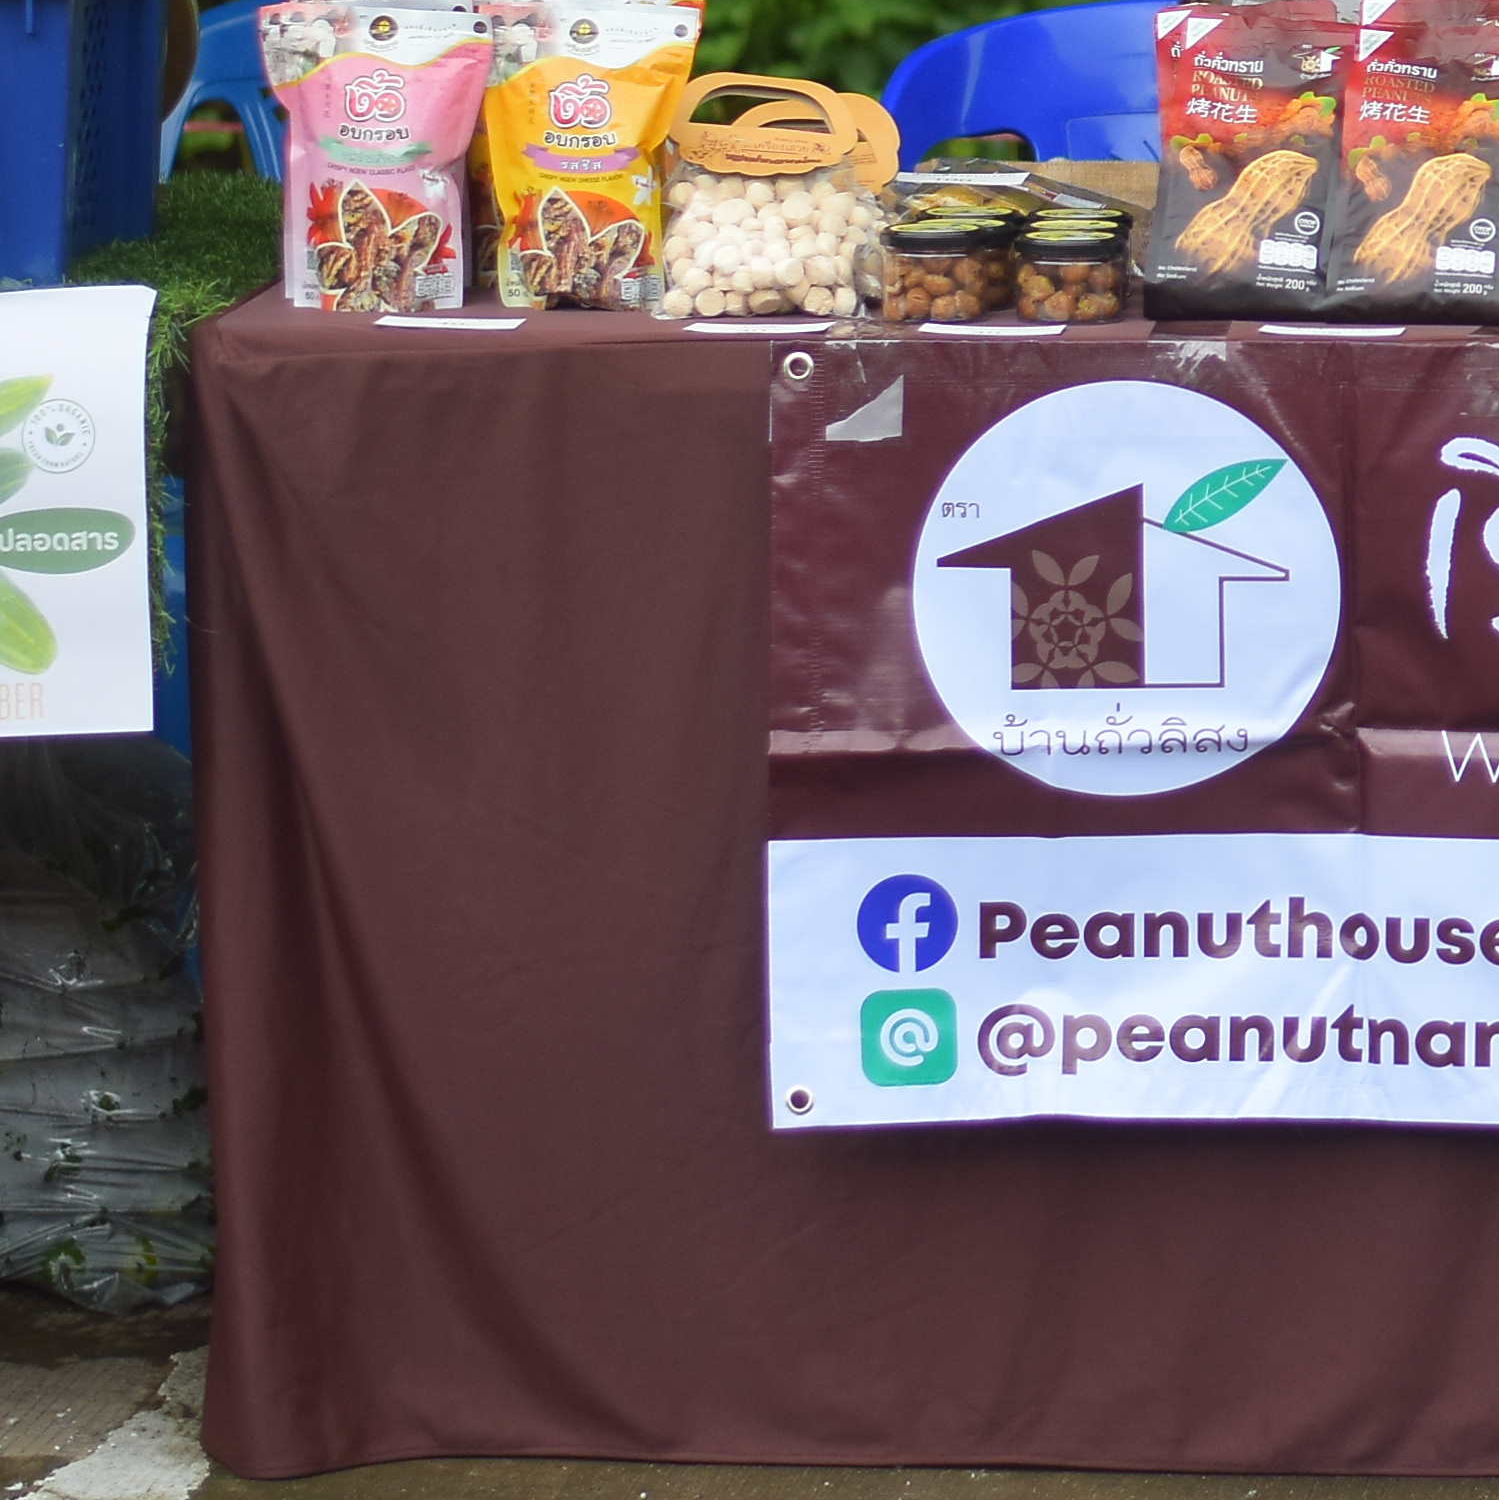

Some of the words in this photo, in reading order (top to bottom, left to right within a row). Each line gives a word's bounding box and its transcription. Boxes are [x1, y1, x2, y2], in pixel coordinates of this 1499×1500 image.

[1193, 51, 1264, 74] ถั่วคั่วทราย
[1366, 59, 1438, 79] ถั่วคั่วทราย
[1365, 74, 1436, 93] ROASTED
[1186, 97, 1258, 124] 烤花生
[1359, 100, 1431, 125] 烤花生
[339, 124, 411, 142] อบกรอบ
[544, 131, 617, 148] อบกรอบ
[1285, 278, 1306, 291] 200
[1462, 283, 1483, 295] 200
[940, 499, 981, 520] ตรา
[992, 702, 1249, 757] บ้านถั่วลิสง
